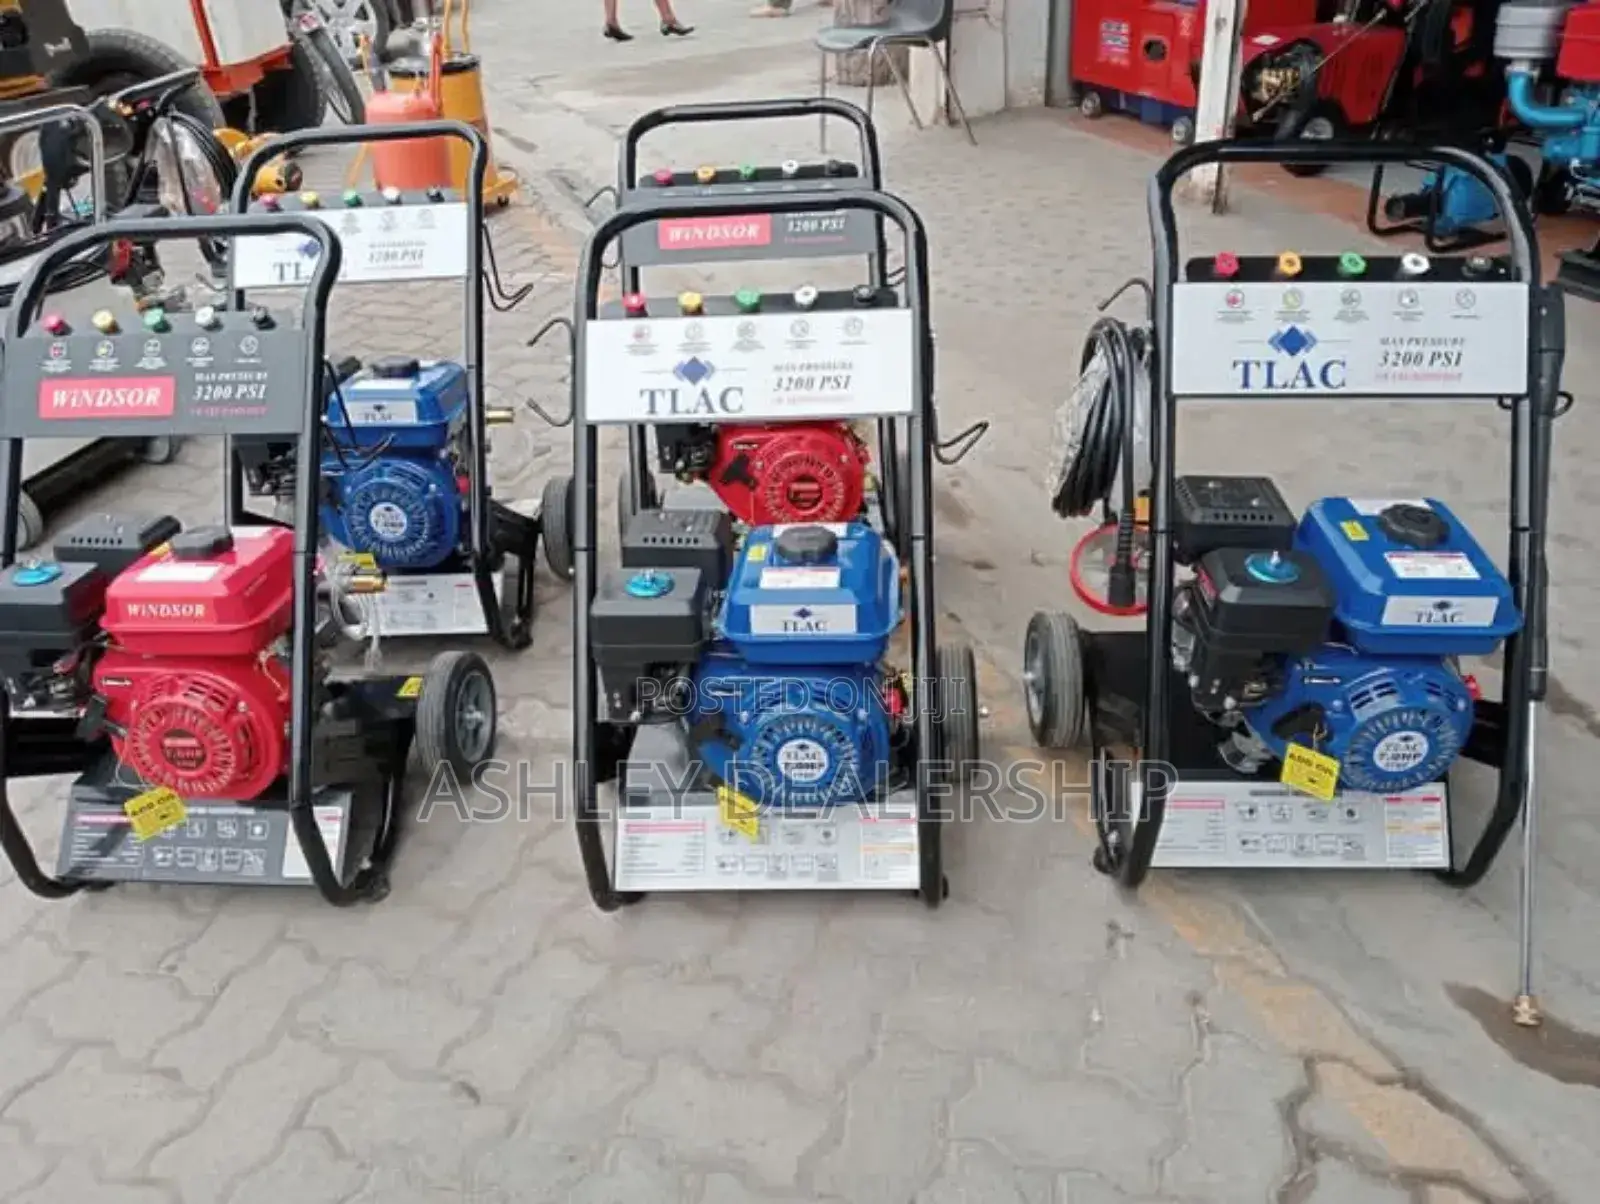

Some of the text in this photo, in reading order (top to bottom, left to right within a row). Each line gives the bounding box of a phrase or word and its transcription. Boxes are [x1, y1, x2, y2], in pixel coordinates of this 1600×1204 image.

[820, 216, 846, 230] PSI
[1378, 351, 1463, 367] 3200 PSI
[1232, 359, 1347, 389] TLAC
[772, 374, 852, 392] 3200 PSI
[192, 383, 268, 401] 3200 PSI
[639, 386, 745, 415] TLAC
[1412, 610, 1465, 623] TLAC
[782, 619, 829, 632] TLAC
